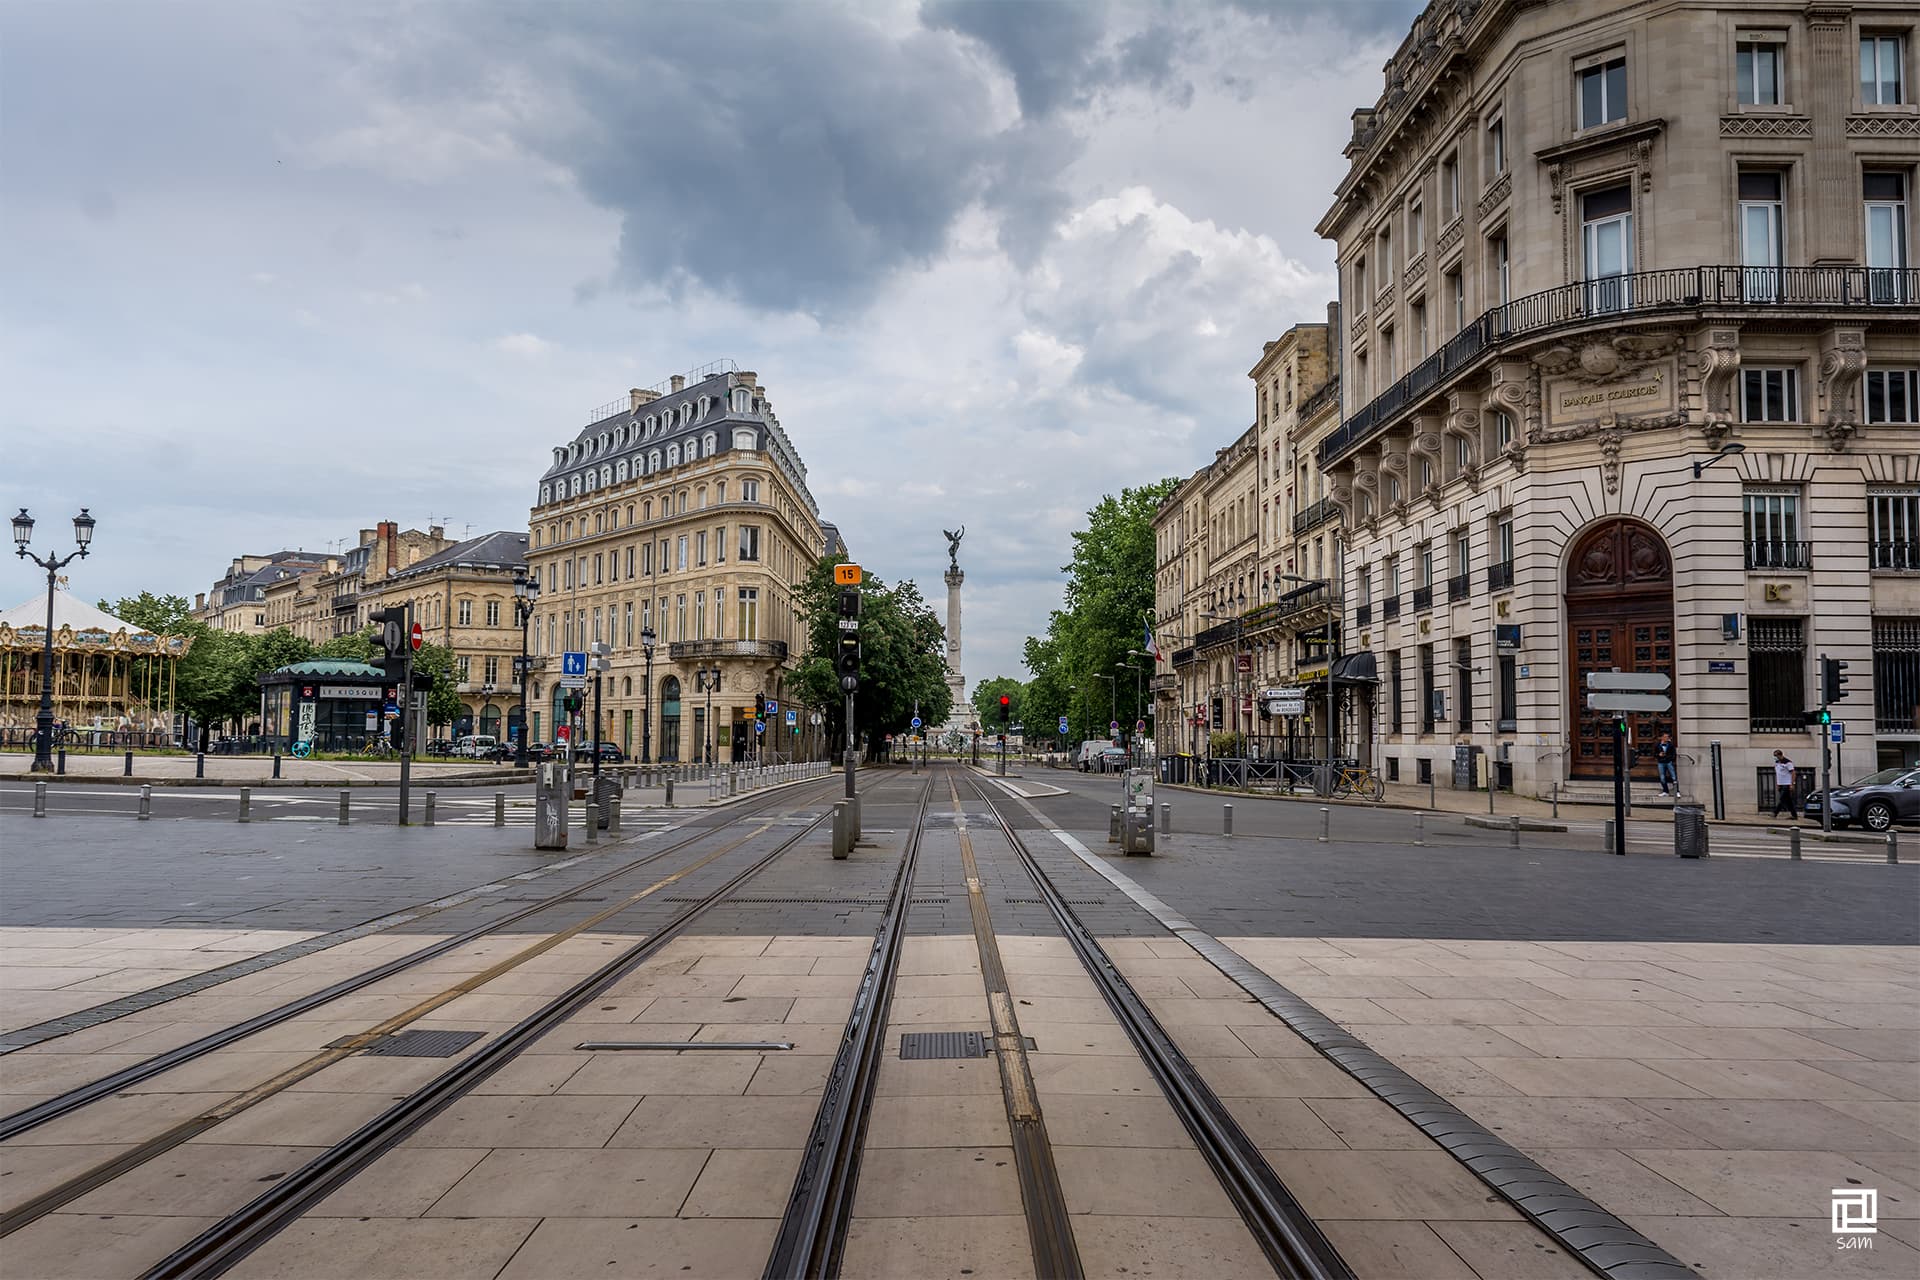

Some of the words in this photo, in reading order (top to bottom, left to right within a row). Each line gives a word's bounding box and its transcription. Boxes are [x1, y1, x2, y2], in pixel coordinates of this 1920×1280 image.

[1563, 393, 1604, 408] BANQUE
[1607, 385, 1657, 401] COURTOIS
[842, 569, 854, 580] 15
[1765, 583, 1792, 603] BC
